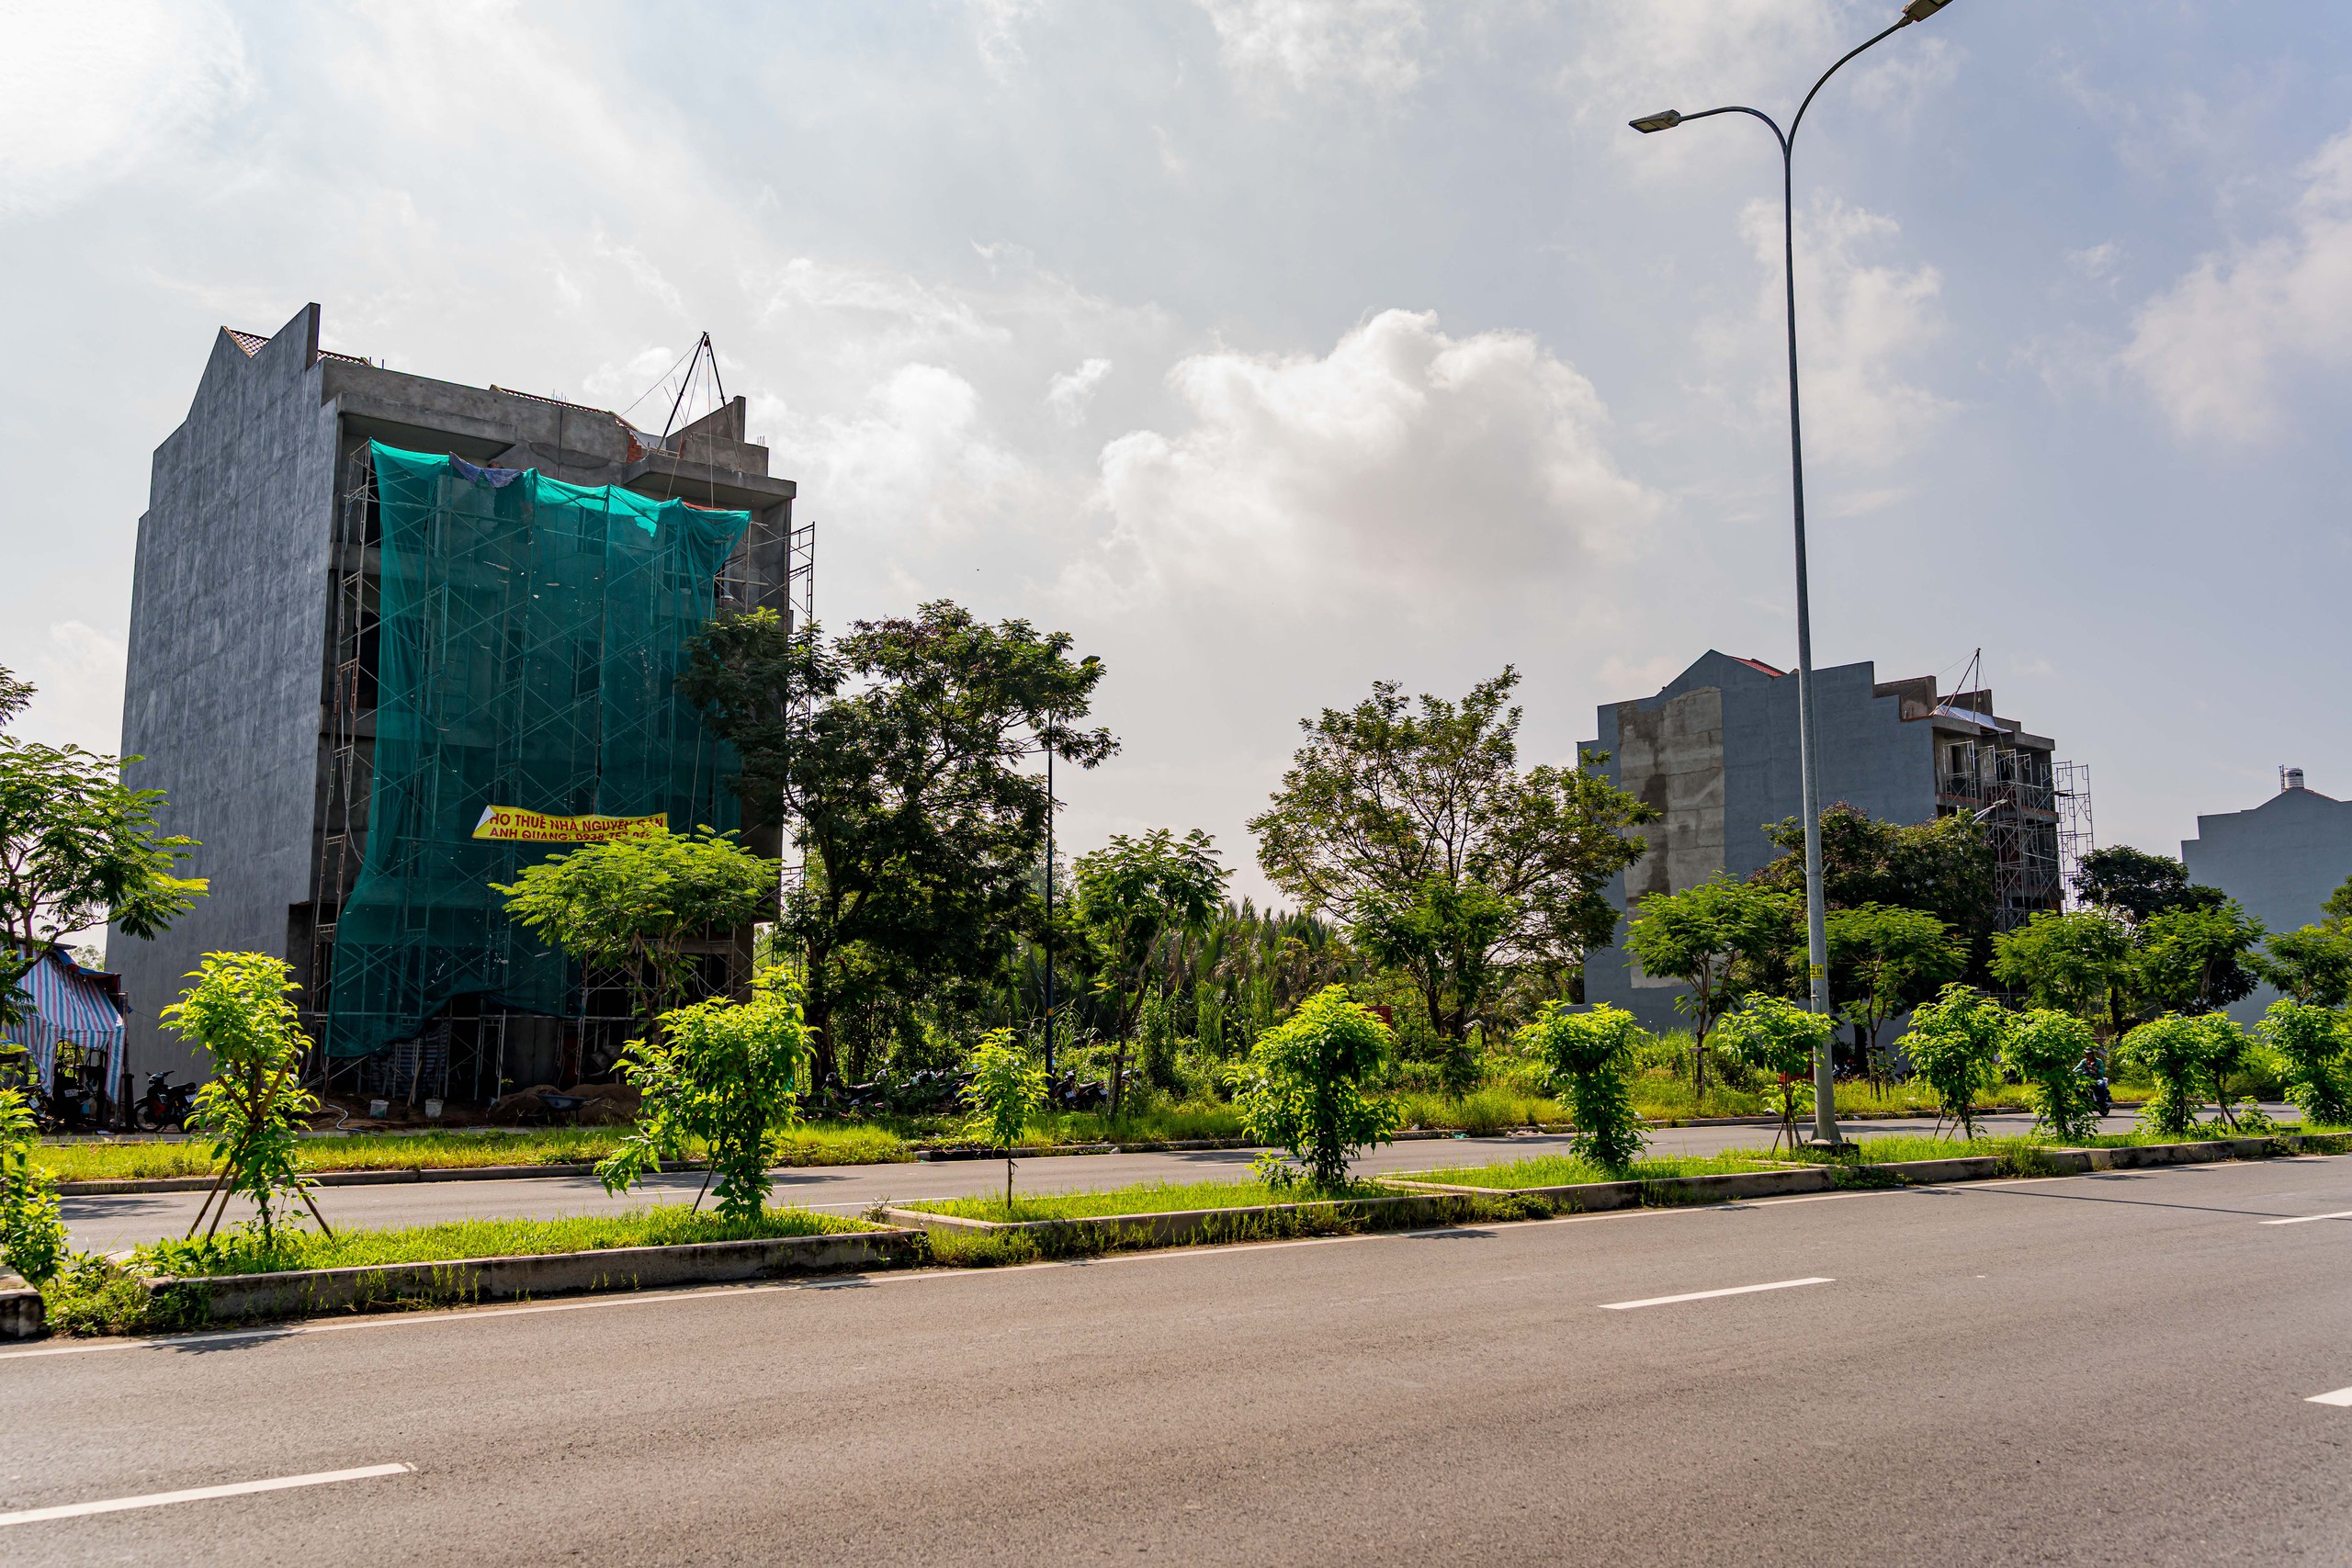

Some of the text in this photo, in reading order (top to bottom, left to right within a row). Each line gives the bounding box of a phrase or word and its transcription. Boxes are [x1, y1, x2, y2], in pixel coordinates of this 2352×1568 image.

[490, 813, 511, 826] HO
[514, 814, 547, 829] THUÊ
[549, 818, 579, 831] NHÀ
[489, 827, 518, 839] ANH
[521, 829, 572, 840] QUANG:
[575, 832, 605, 840] 0938
